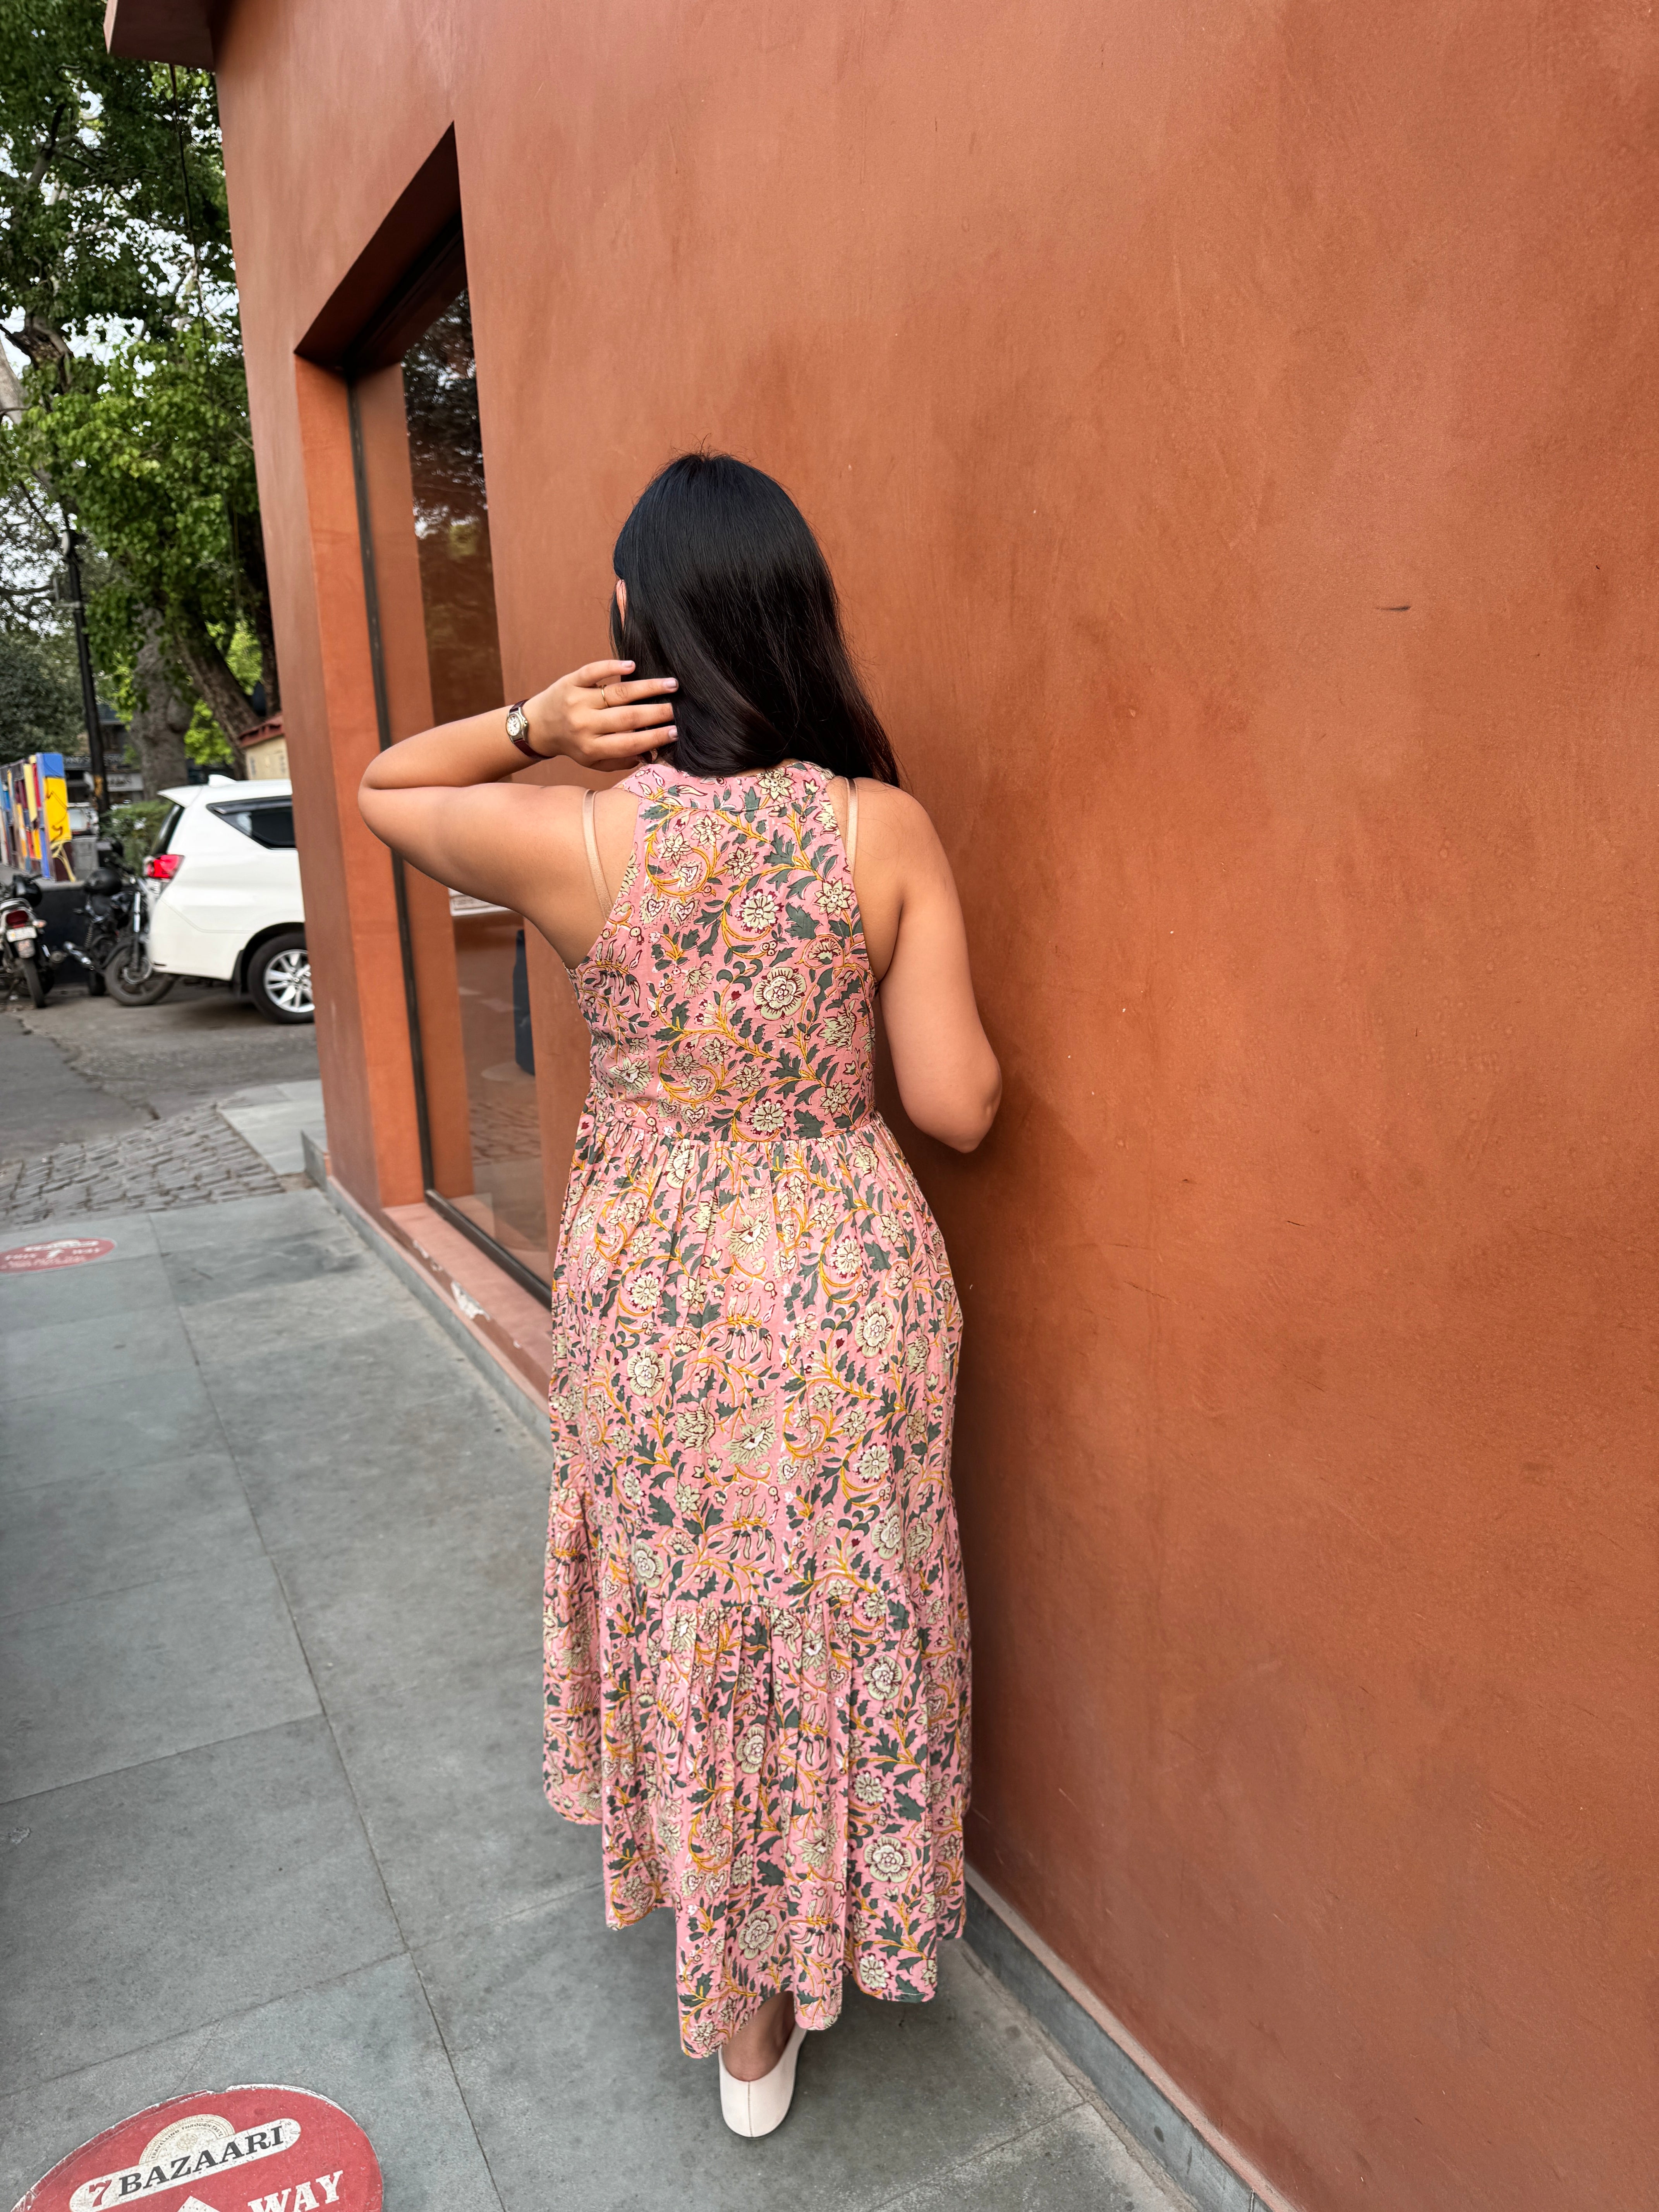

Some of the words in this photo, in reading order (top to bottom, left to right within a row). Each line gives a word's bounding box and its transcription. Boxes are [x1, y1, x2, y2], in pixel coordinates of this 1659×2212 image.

[151, 2130, 180, 2159] TRAVELLING
[89, 2179, 112, 2207] 7
[118, 2125, 284, 2197] BAZAARI
[247, 2170, 343, 2212] WAY
